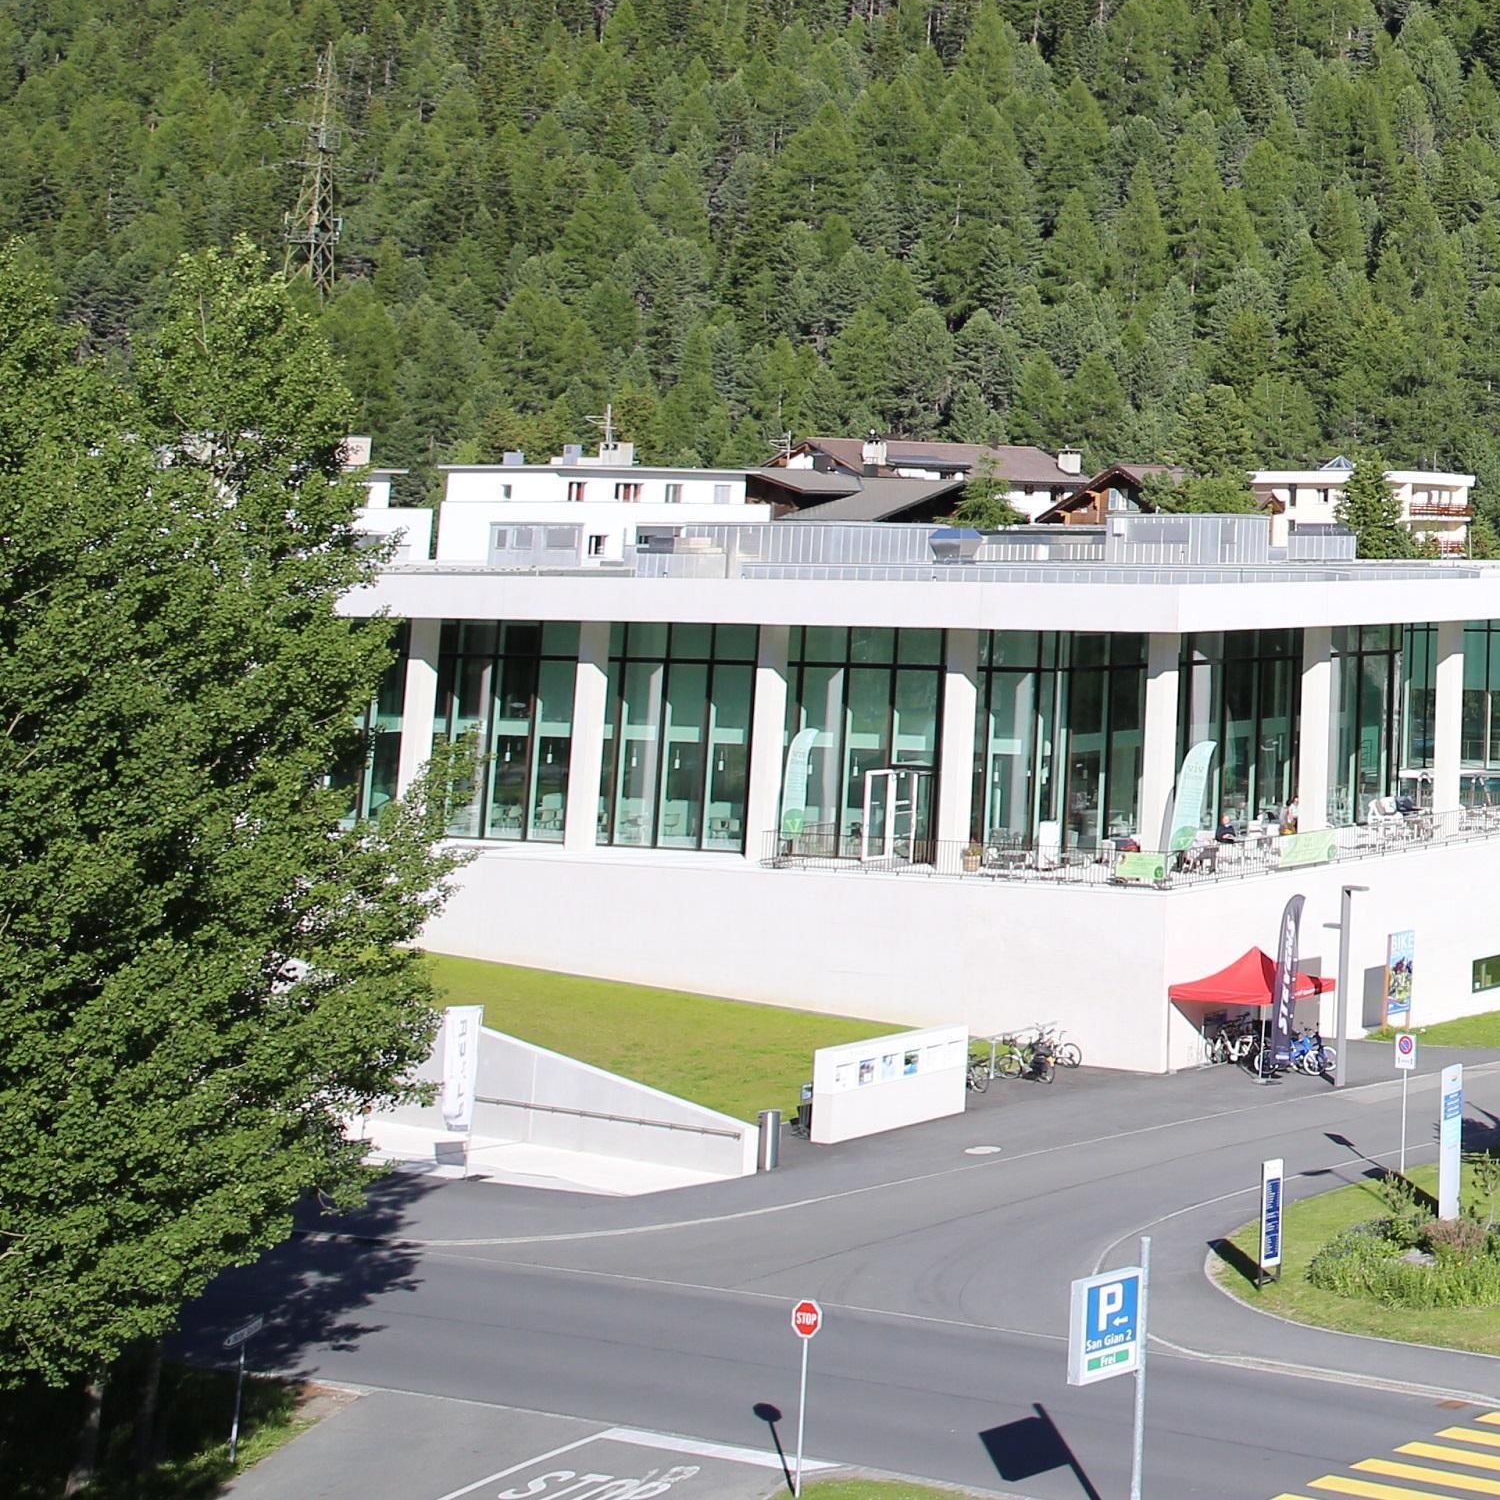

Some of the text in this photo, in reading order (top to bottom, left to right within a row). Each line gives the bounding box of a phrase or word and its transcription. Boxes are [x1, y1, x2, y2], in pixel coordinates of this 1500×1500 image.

[1391, 931, 1414, 949] BIKE
[1278, 914, 1296, 1035] STEVENS
[1098, 1282, 1123, 1332] P
[796, 1311, 817, 1325] STOP
[1086, 1329, 1132, 1352] San Gian 2
[1100, 1353, 1117, 1367] Frei
